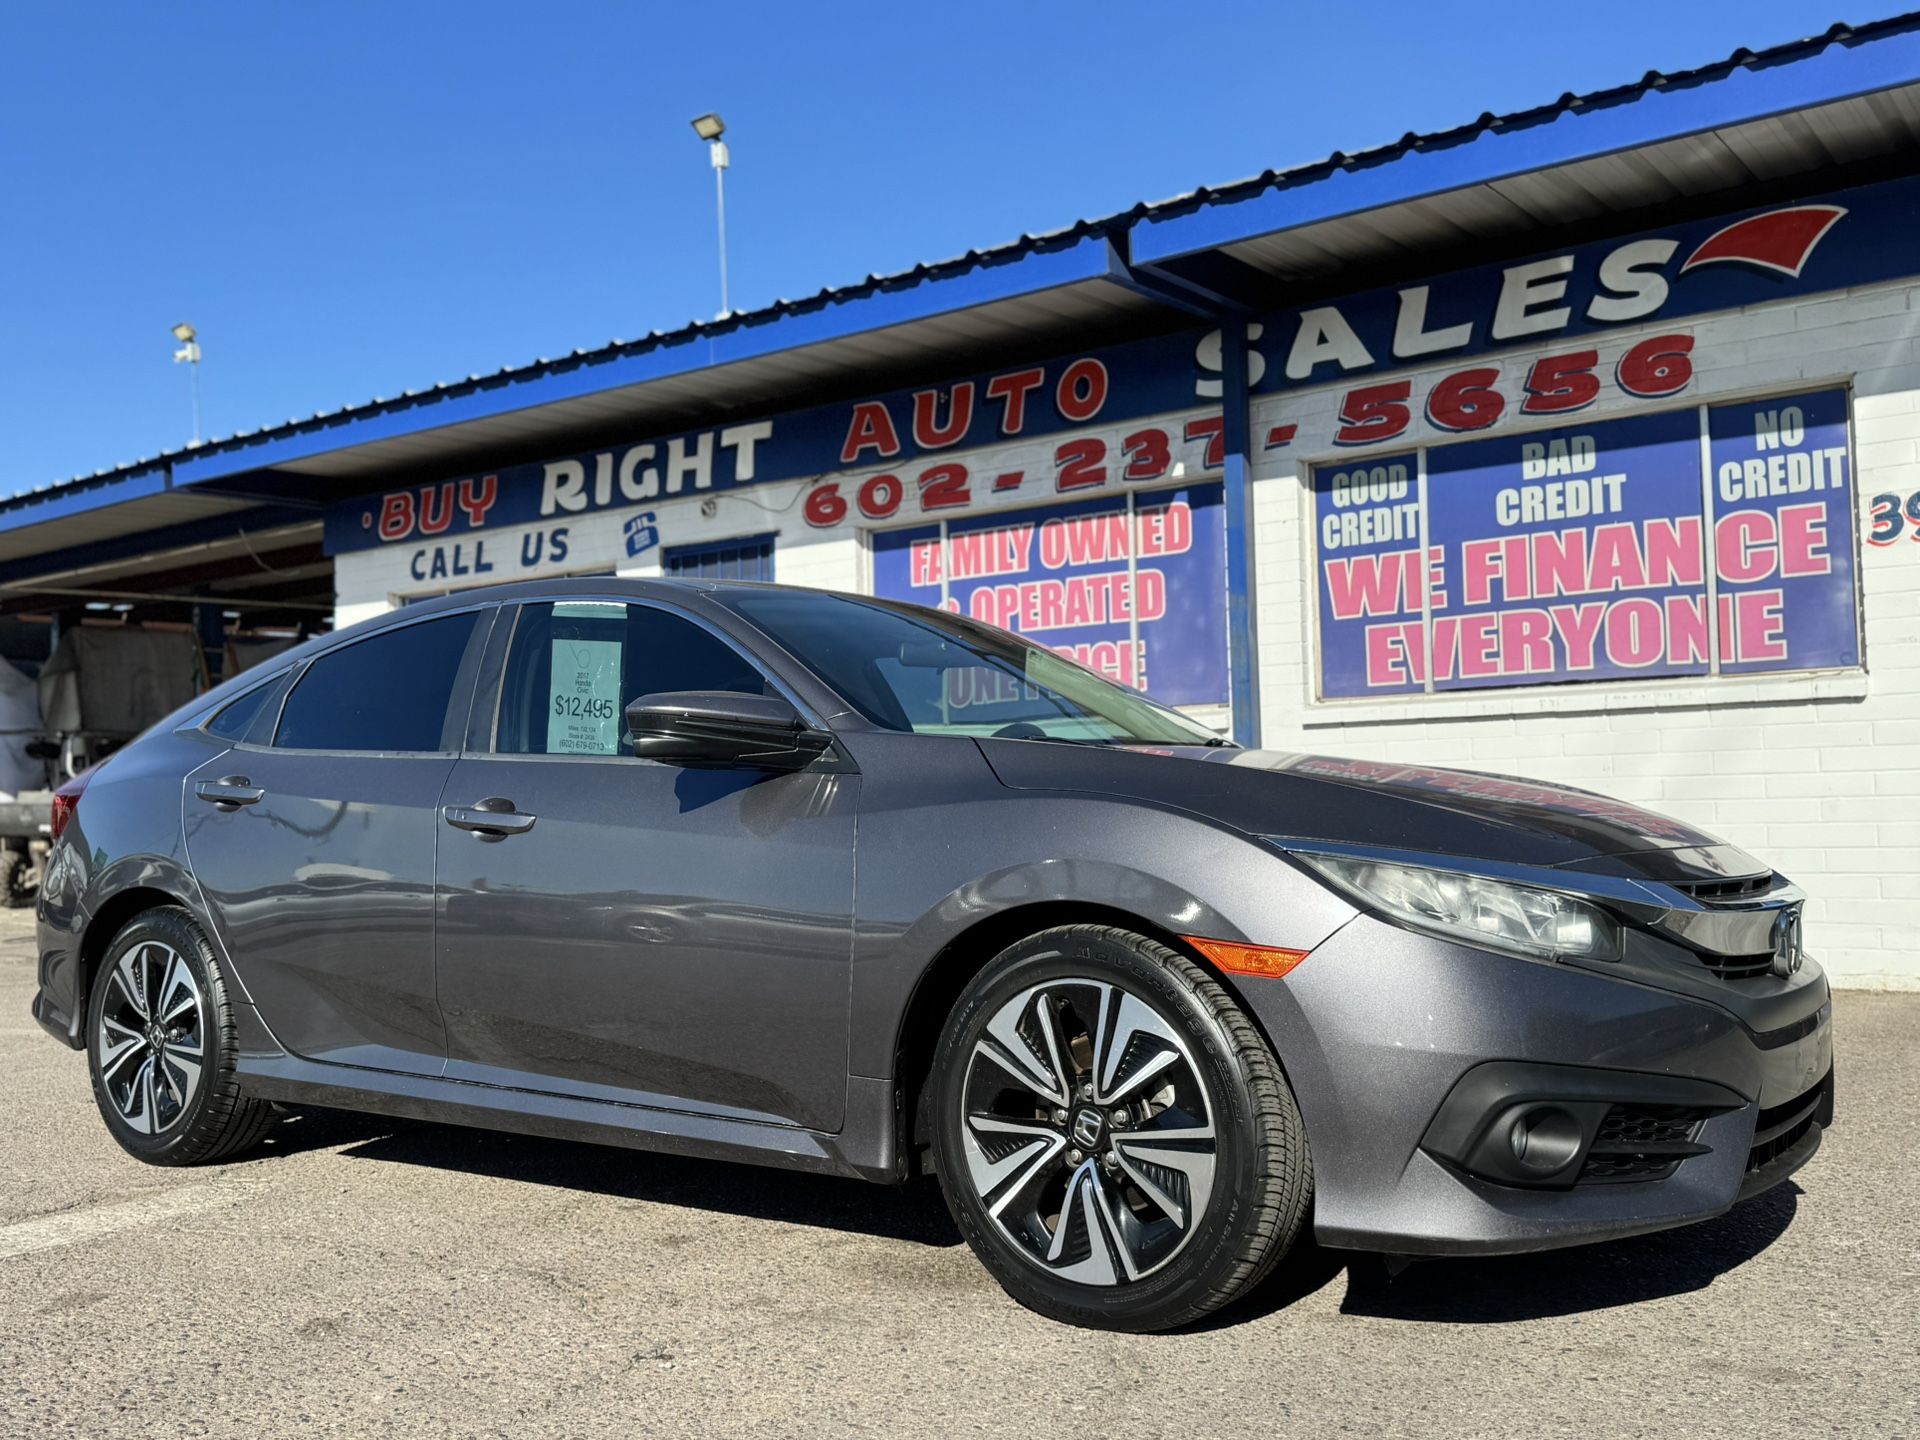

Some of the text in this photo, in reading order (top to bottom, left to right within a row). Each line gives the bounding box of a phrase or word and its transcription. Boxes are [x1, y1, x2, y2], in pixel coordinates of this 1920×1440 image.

[378, 239, 1681, 542] BUY RIGHT AUTO SALES
[1755, 406, 1805, 452] NO
[1522, 435, 1597, 480] BAD
[1718, 447, 1847, 502] CREDIT
[1331, 464, 1408, 508] GOOD
[1495, 473, 1627, 526] CREDIT
[910, 502, 1192, 587] FAMILY OWNED
[1322, 503, 1419, 550] CREDIT
[411, 528, 569, 581] CALL US
[1324, 501, 1831, 620] WE FINANCE
[970, 568, 1167, 633] OPERATED
[1365, 588, 1788, 688] EVERYONE
[555, 695, 613, 720] $12,495
